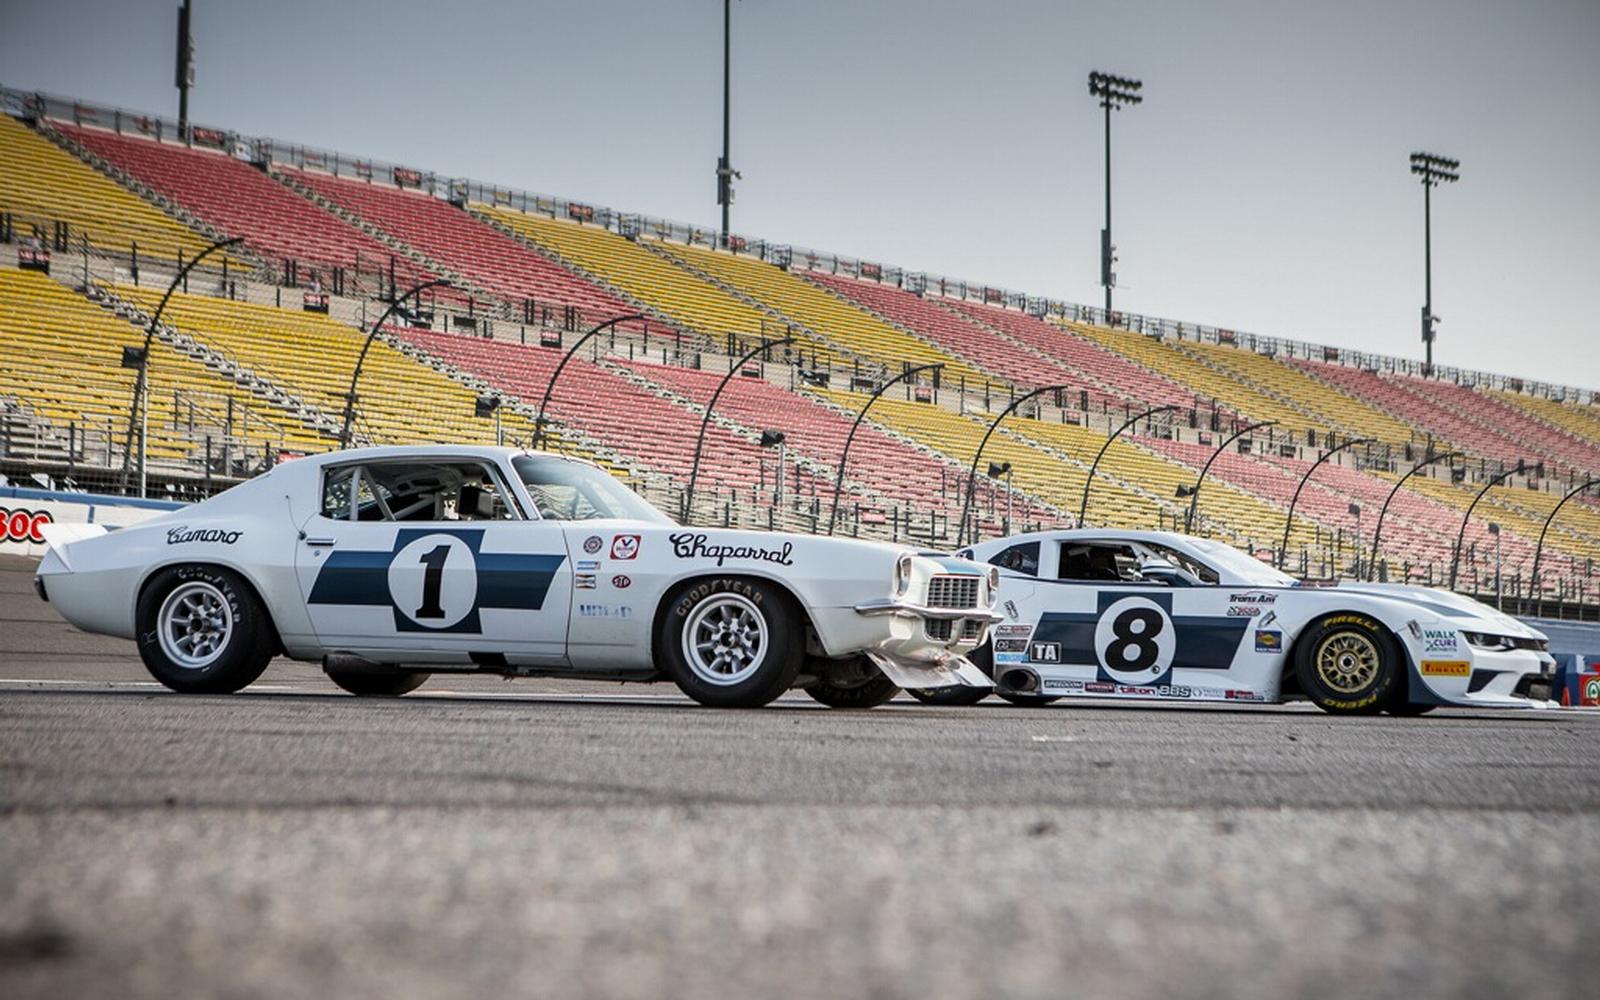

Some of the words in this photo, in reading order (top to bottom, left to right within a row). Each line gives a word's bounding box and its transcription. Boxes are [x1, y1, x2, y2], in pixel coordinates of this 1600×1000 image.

[166, 526, 243, 545] Camaro
[669, 533, 793, 567] Chaparral
[415, 544, 452, 619] 1
[613, 575, 630, 588] STP
[676, 579, 763, 617] GOODYEAR
[1323, 615, 1378, 631] PIRELLI
[1105, 607, 1164, 672] 8
[1424, 630, 1456, 638] WALK
[1434, 639, 1457, 647] CURE
[1034, 644, 1057, 661] TA
[1425, 663, 1467, 673] PIRELLI
